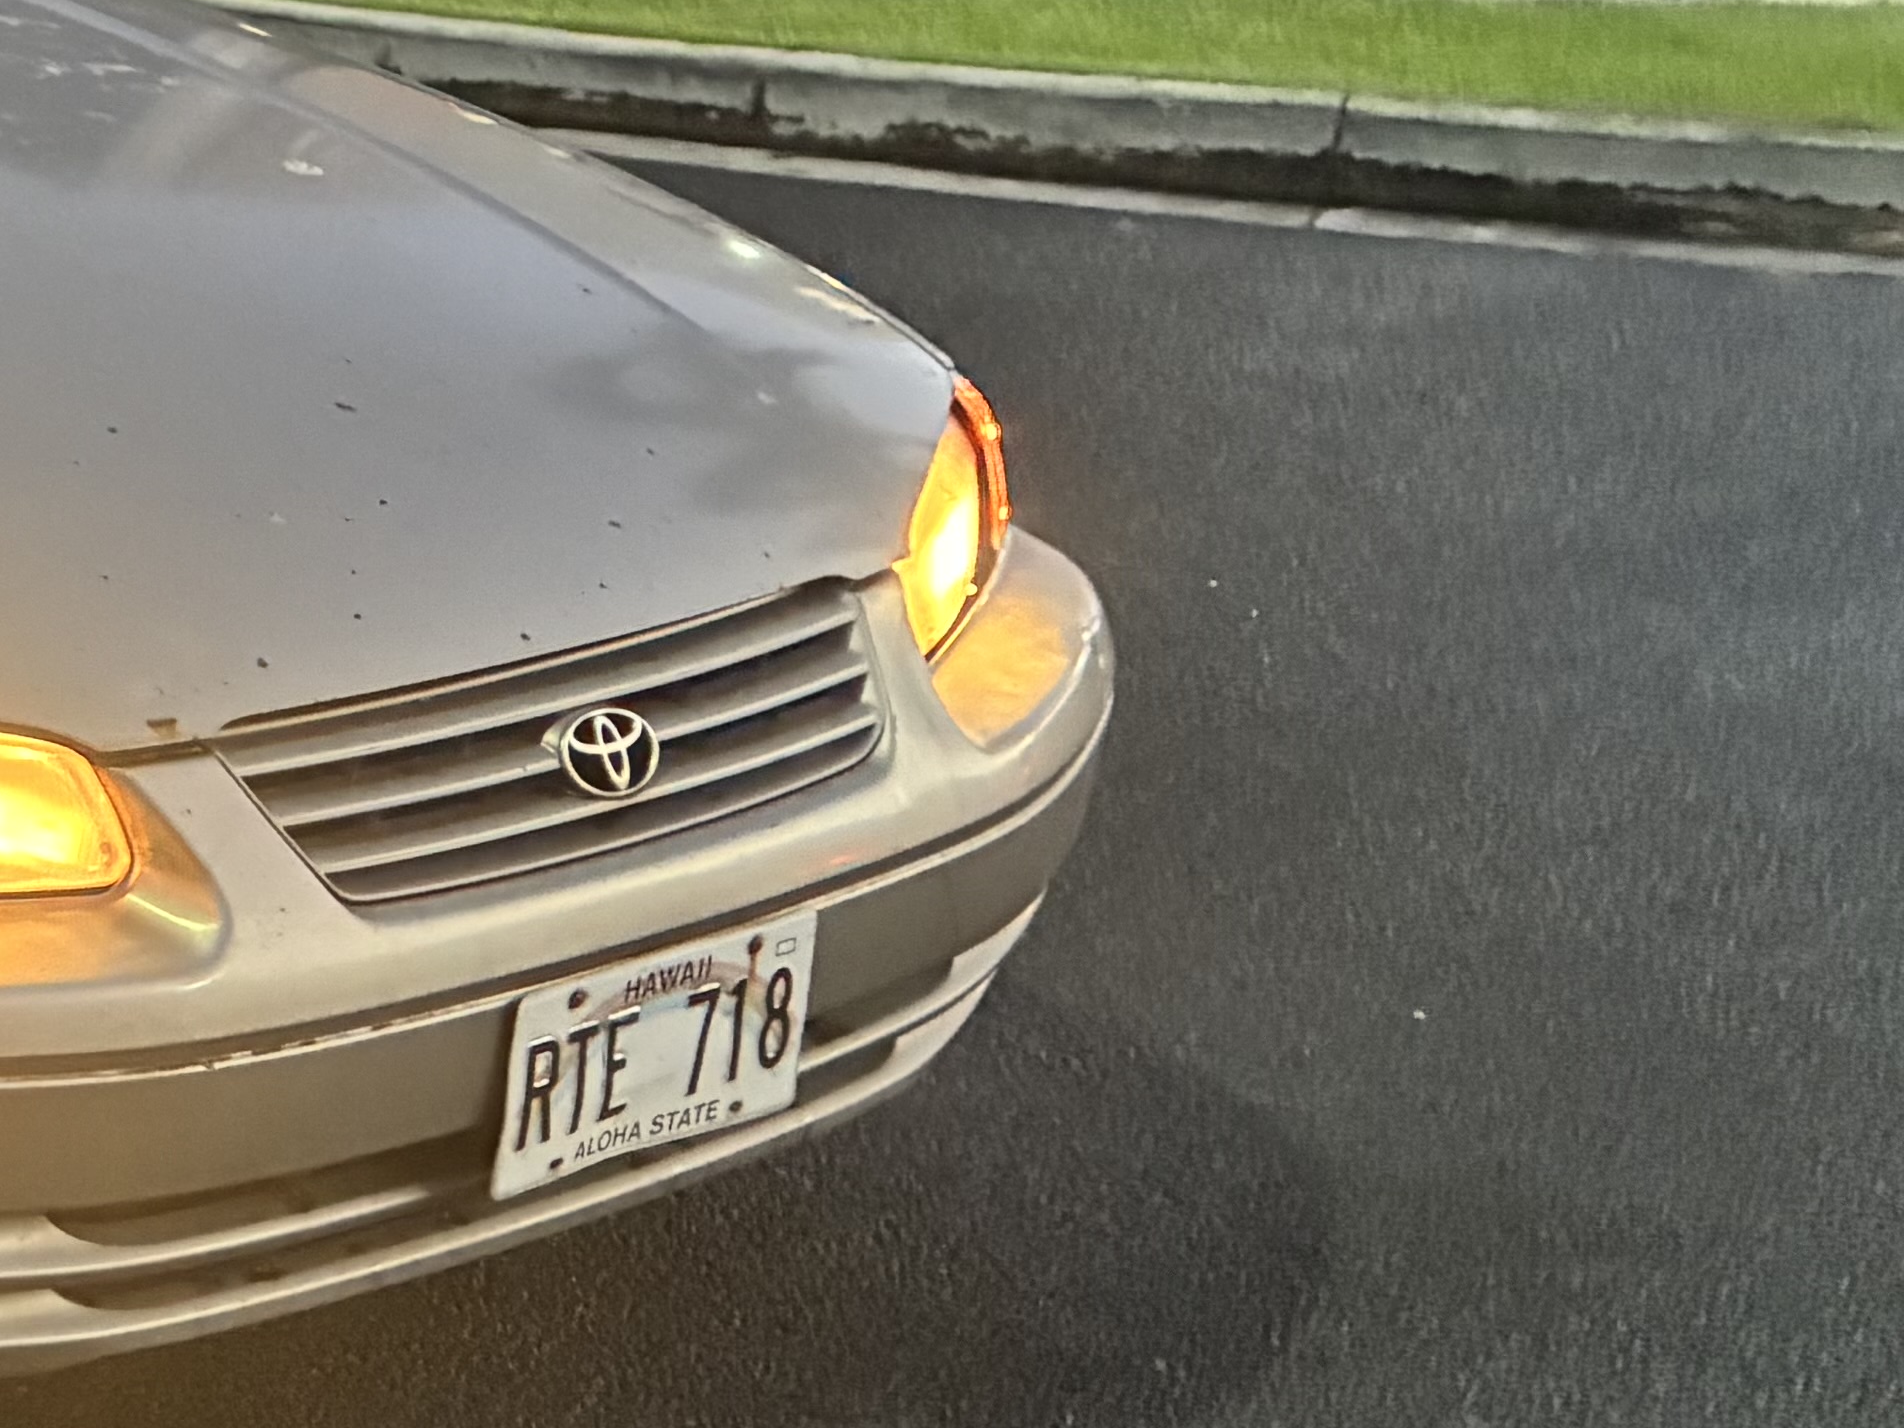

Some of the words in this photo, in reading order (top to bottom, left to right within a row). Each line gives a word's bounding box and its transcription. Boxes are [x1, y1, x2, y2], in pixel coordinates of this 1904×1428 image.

[624, 954, 714, 1004] HAWAII
[514, 1005, 641, 1152] RTE
[684, 966, 794, 1097] 718
[573, 1120, 642, 1161] ALOHA
[648, 1097, 720, 1136] STATE
